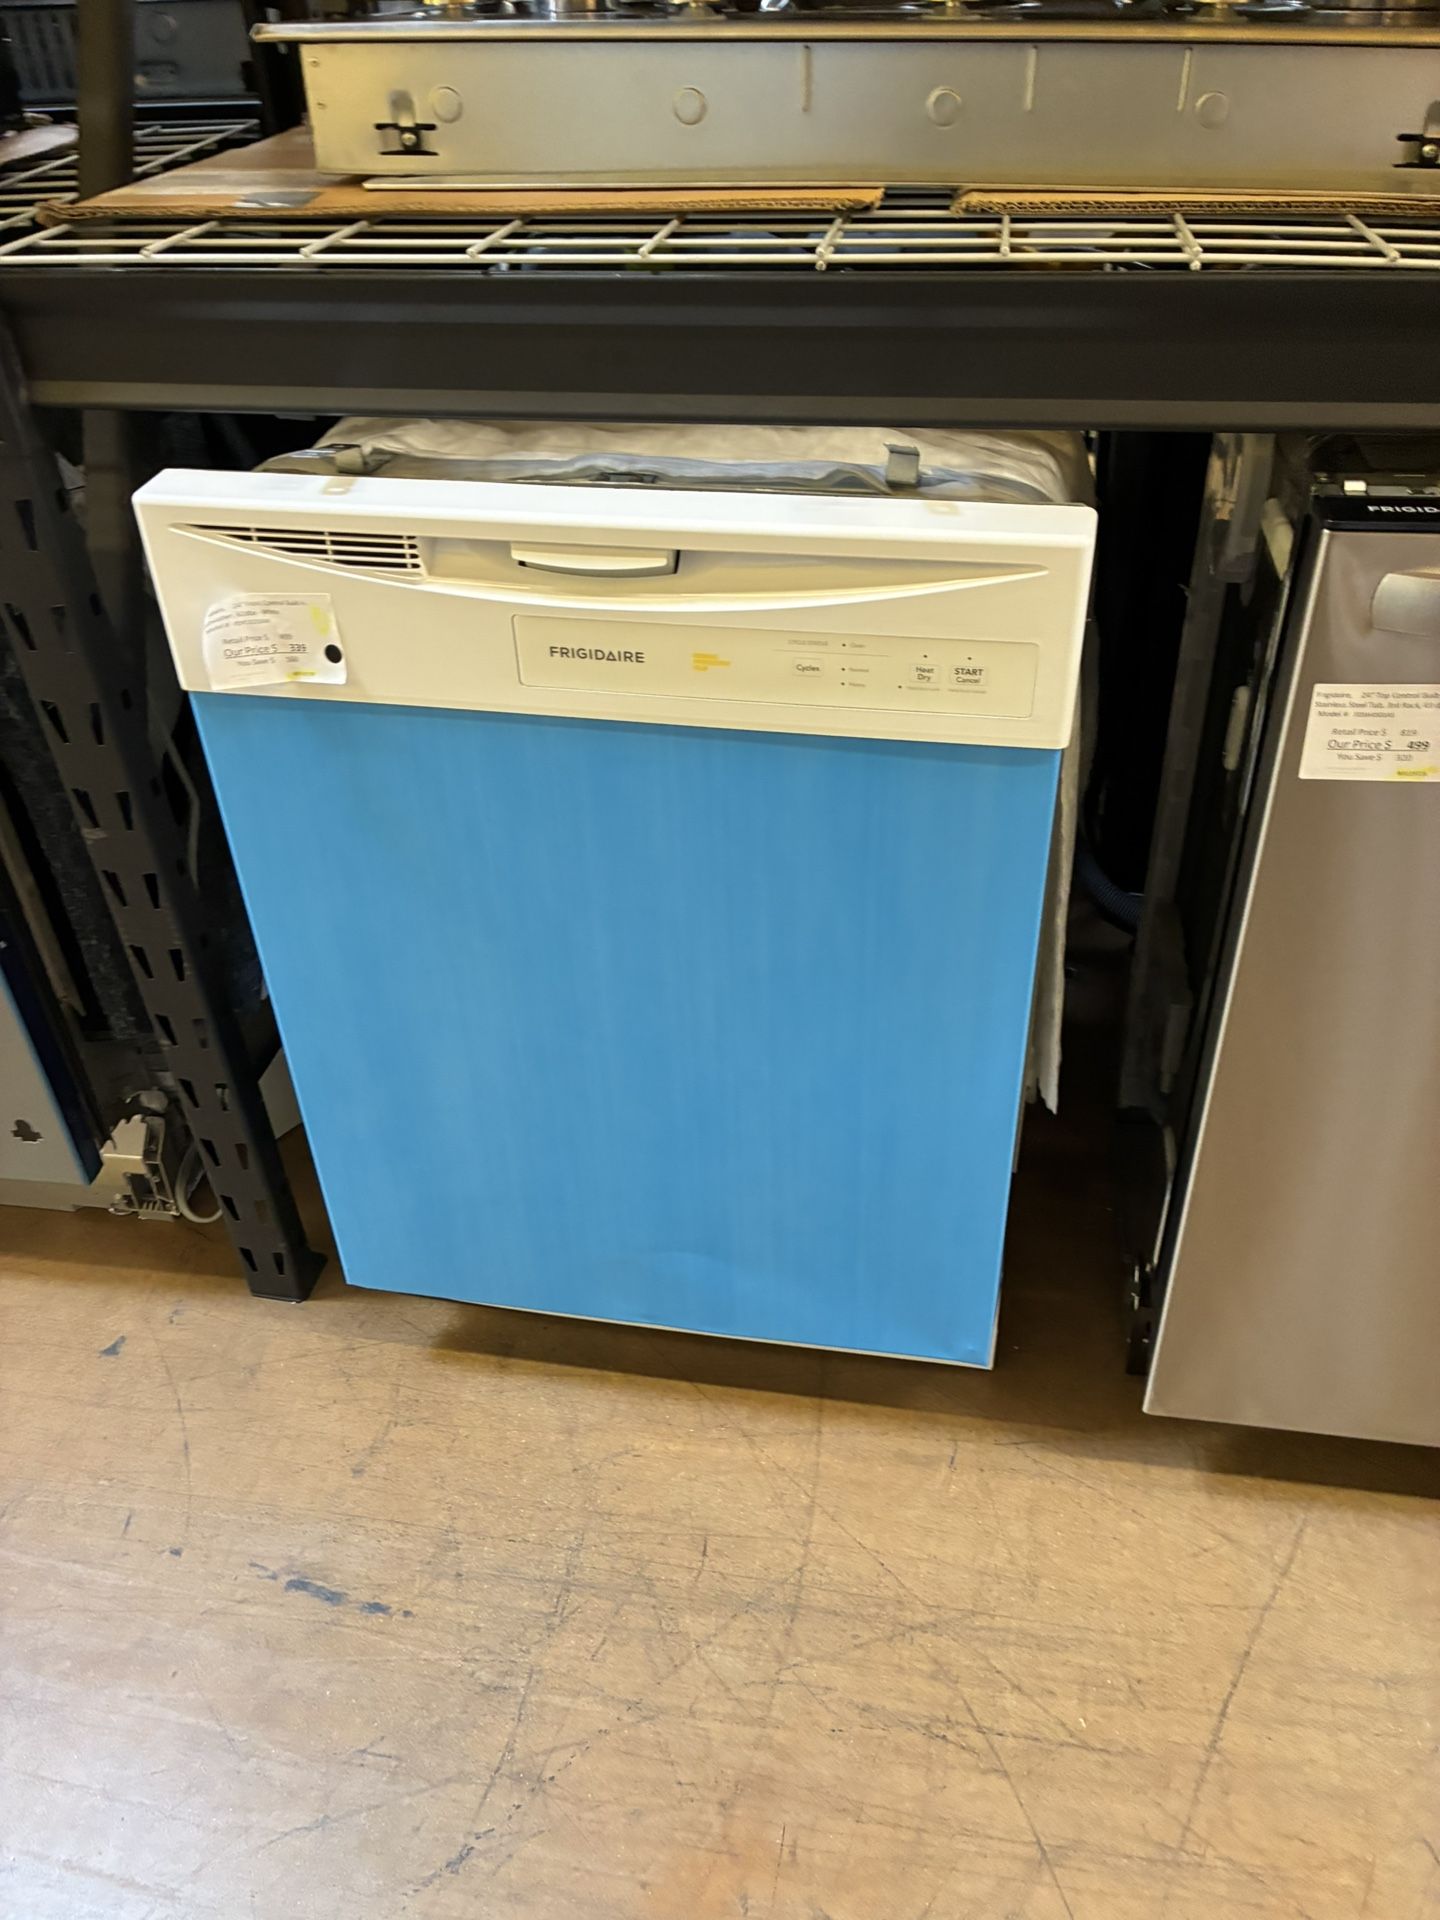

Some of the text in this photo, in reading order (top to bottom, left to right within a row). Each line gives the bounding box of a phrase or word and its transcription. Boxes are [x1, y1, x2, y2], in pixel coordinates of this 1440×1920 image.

[1367, 505, 1440, 514] FRIGID
[224, 647, 243, 658] Our
[244, 645, 270, 656] Price
[550, 646, 645, 663] FRIGIDAIRE
[796, 663, 820, 672] Cycles
[916, 666, 934, 674] Heat
[954, 667, 984, 676] START
[917, 673, 931, 682] Dry
[956, 676, 981, 684] Cancel
[1328, 740, 1350, 749] Our
[1352, 740, 1382, 750] Price
[1406, 741, 1430, 750] 499
